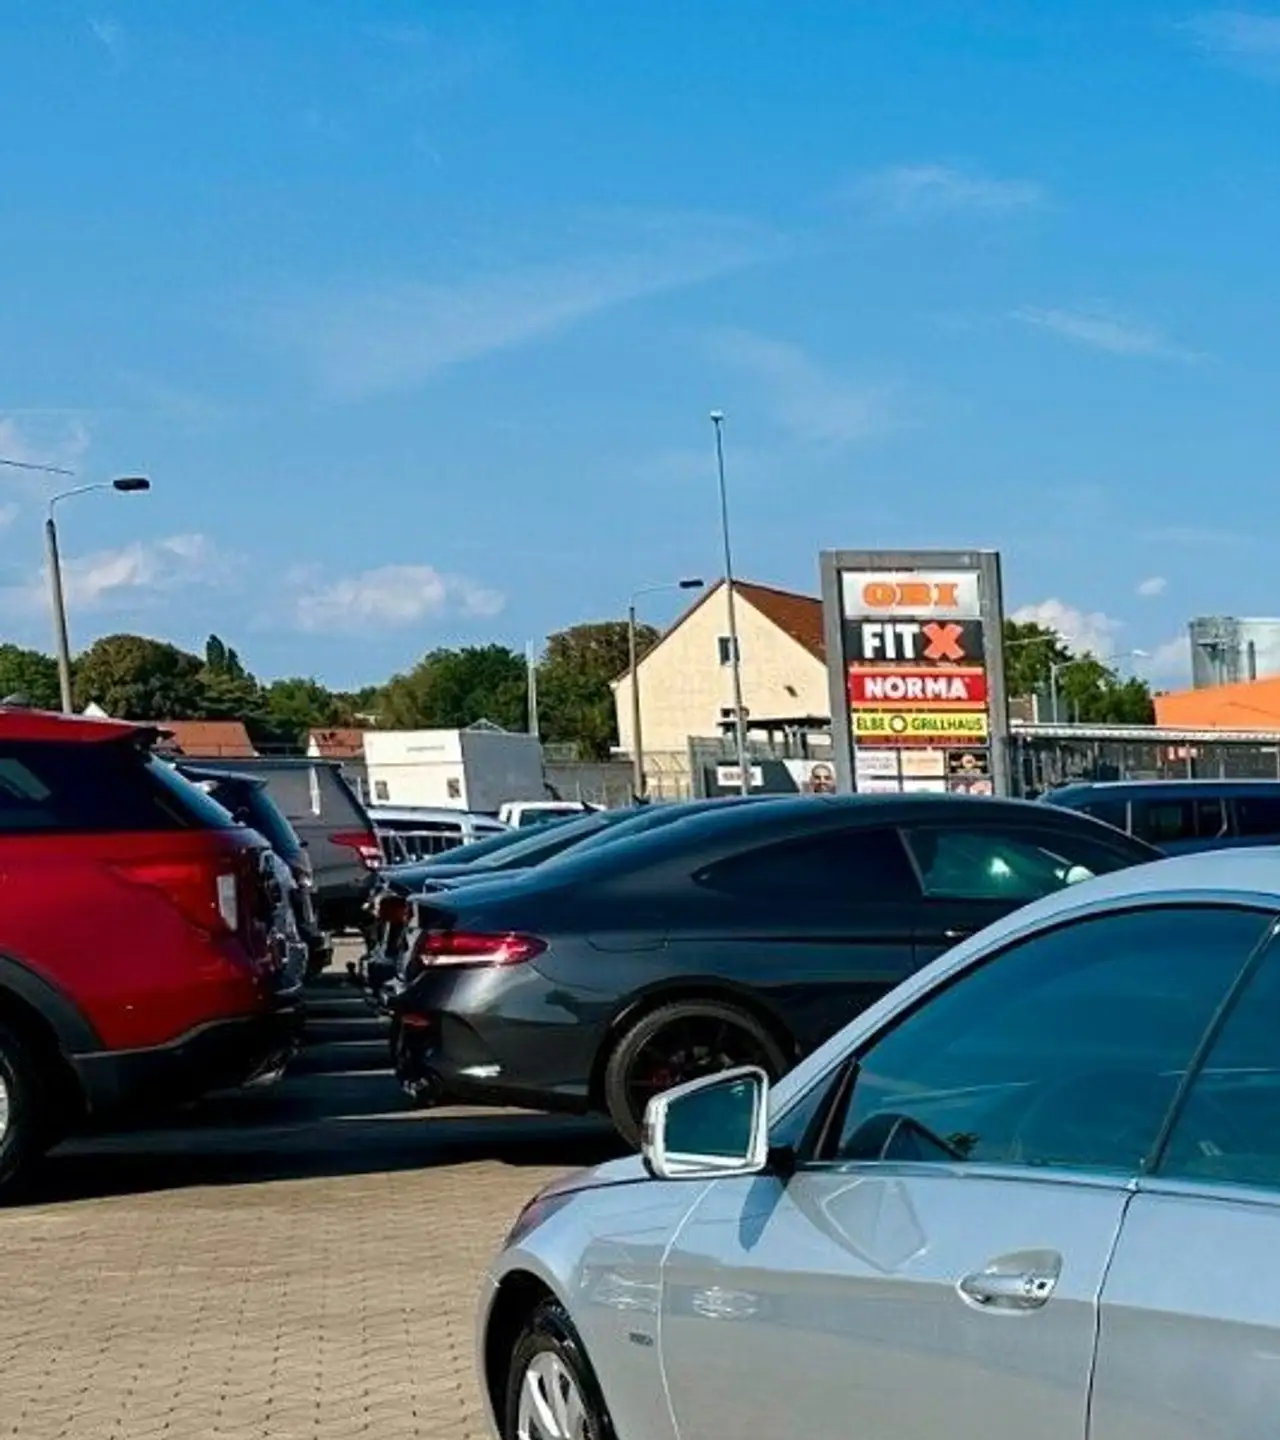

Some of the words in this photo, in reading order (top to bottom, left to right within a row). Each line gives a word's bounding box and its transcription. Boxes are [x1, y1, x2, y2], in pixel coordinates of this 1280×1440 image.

[863, 676, 969, 700] NORMA
[856, 717, 886, 731] ELBE
[911, 716, 983, 731] GRILLHAUS
